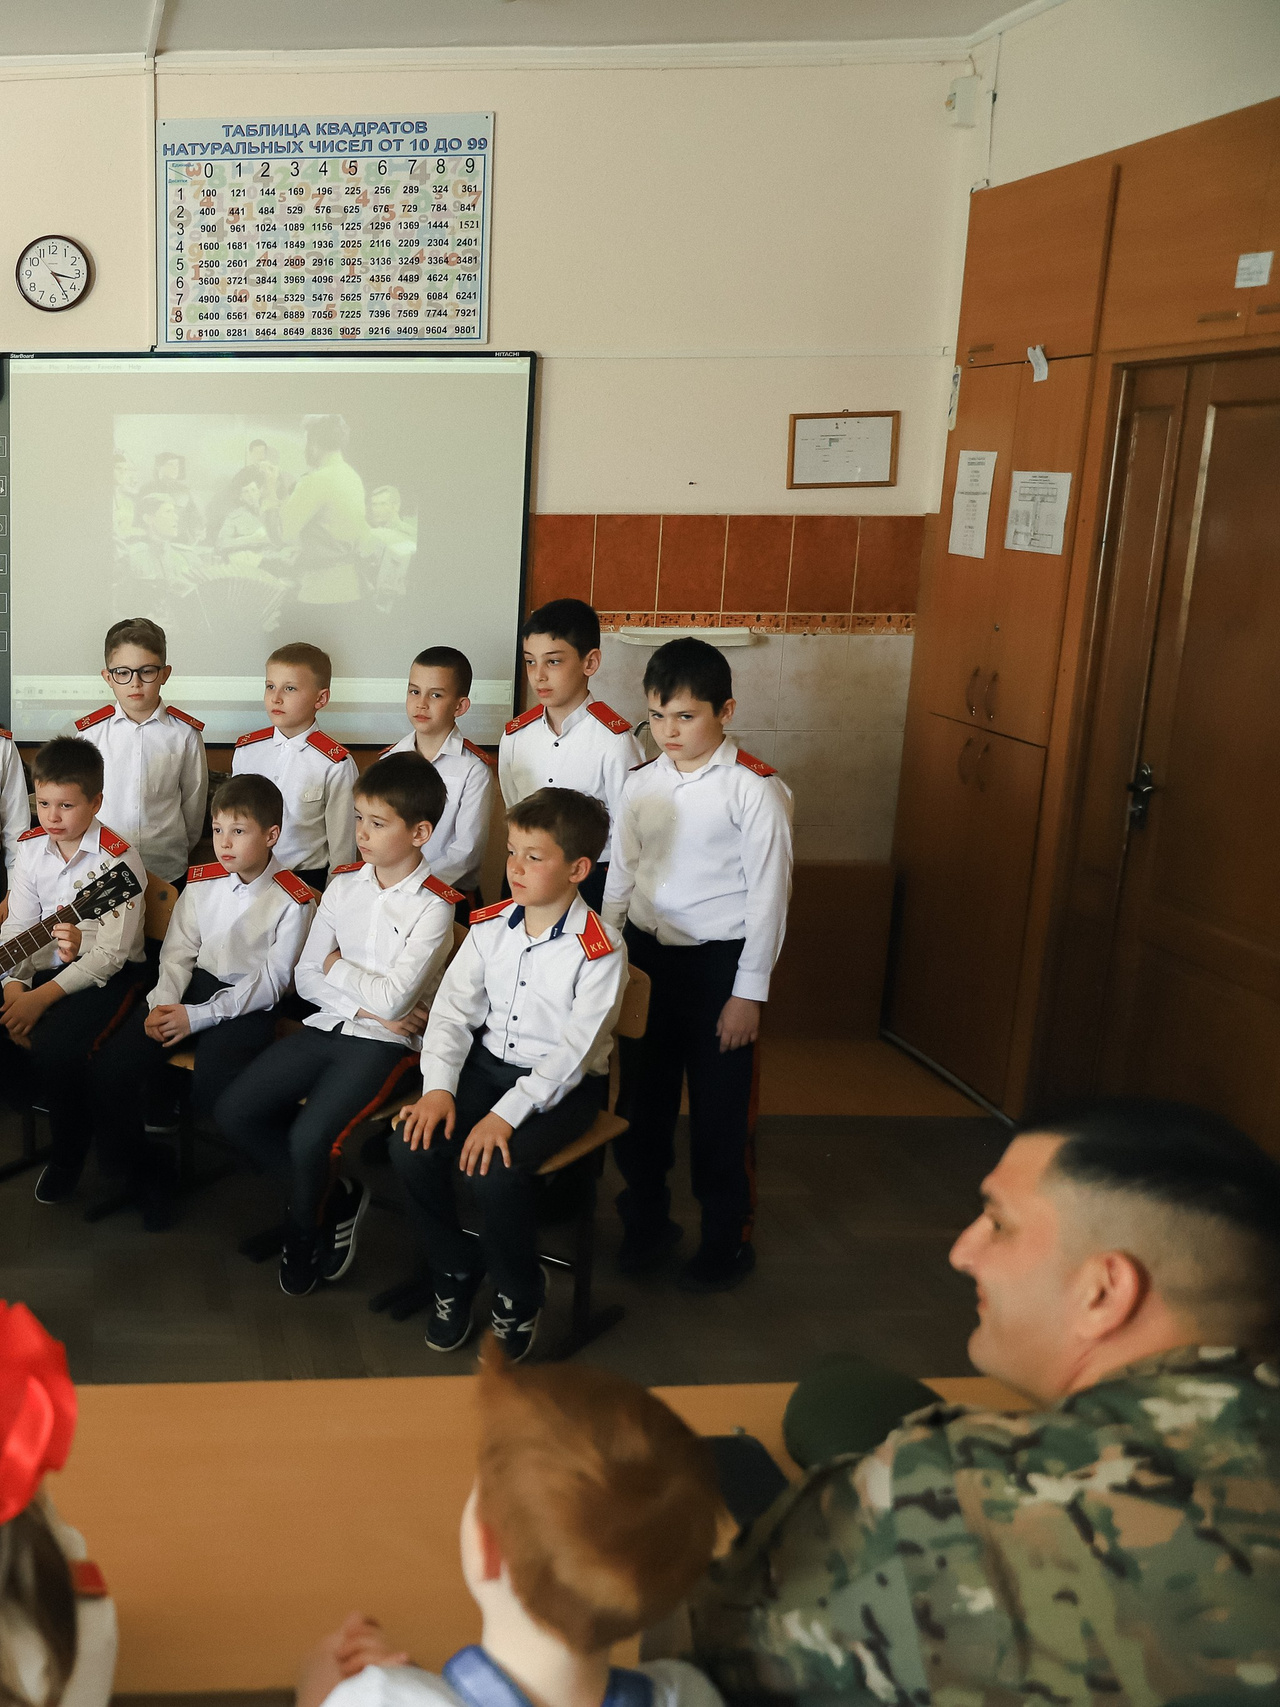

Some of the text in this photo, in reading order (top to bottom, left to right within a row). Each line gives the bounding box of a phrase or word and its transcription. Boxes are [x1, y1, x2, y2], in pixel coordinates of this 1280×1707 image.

[222, 121, 428, 138] ТАБЛИЦА КВАДРАТОВ
[163, 137, 488, 156] НАТУРАЛЬНЫХ ЧИСЕЛ ОТ 10 ДО 99
[204, 158, 475, 178] 0 1 2 3 4 5 6 7 8 9
[178, 184, 477, 200] 1 100 121 144 169 196 225 256 289 324 361
[177, 203, 476, 218] 2 400 441 484 529 576 625 676 729 784 841
[177, 219, 480, 236] 3 900 961 1024 1089 1156 1225 1296 1369 1444 1521
[48, 245, 58, 255] 12
[176, 238, 477, 253] 4 1600 1681 1764 1849 1936 2025 2116 2209 2304 2401
[39, 248, 45, 258] 11
[29, 257, 40, 267] 10
[70, 256, 77, 266] 2
[176, 256, 477, 270] 5 2500 2601 2704 2809 2916 3025 3136 3249 3364 3481
[25, 269, 32, 279] 9
[74, 269, 81, 279] 3
[176, 273, 476, 289] 6 3600 3721 3844 3969 4096 4225 4356 4489 4624 4761
[29, 282, 36, 292] 8
[69, 282, 76, 291] 4
[39, 290, 45, 300] 7
[49, 293, 57, 304] 6
[176, 292, 477, 306] 7 4900 5041 5184 5329 5476 5625 5776 5929 6084 6241
[175, 309, 477, 323] 8 6400 6561 6724 6889 7056 7225 7396 7569 7744 7921
[176, 326, 476, 340] 9 8100 8281 8464 8649 8836 9025 9216 9409 9604 9801
[121, 871, 136, 886] Cort
